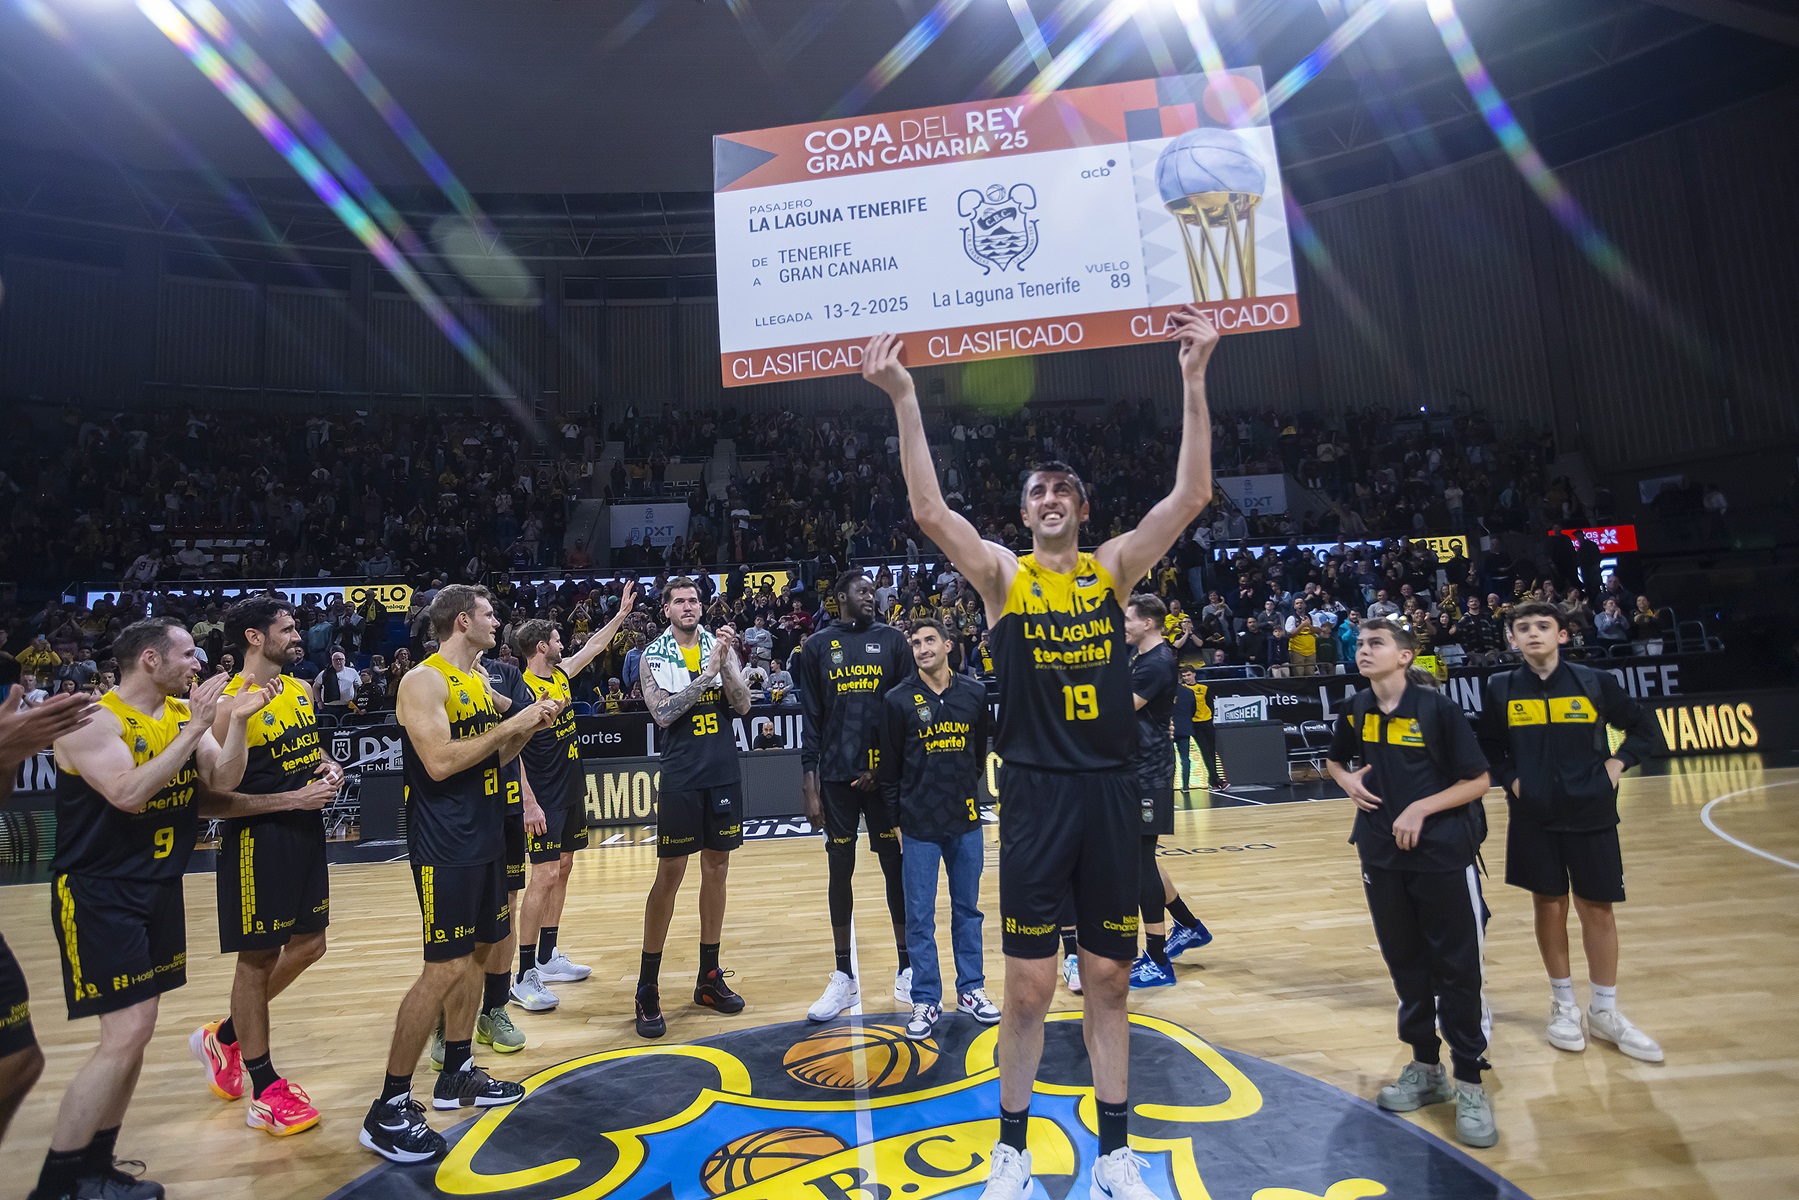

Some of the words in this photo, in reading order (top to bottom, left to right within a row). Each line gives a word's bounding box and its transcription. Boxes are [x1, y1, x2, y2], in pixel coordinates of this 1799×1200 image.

[804, 123, 893, 154] COPA
[900, 116, 958, 142] DEL
[965, 105, 1025, 134] REY
[806, 149, 875, 174] GRAN
[880, 135, 990, 164] CANARIA
[1080, 167, 1110, 179] acb
[749, 198, 813, 214] PASAJERO
[749, 217, 770, 233] LA
[774, 207, 844, 230] LAGUNA
[847, 197, 928, 220] TENERIFE
[752, 257, 768, 267] DE
[778, 242, 852, 264] TENERIFE
[779, 265, 823, 283] GRAN
[828, 256, 898, 277] CANARIA
[1085, 260, 1130, 273] VUELO
[753, 277, 761, 286] A
[932, 292, 950, 307] La
[956, 284, 1014, 307] Laguna
[1017, 276, 1080, 298] Tenerife
[1110, 273, 1131, 289] 89
[755, 312, 813, 327] LLEGADA
[824, 296, 908, 319] 13-2-2025
[1130, 302, 1288, 338] CLAFICADO
[928, 321, 1083, 358] CLASIFICADO
[732, 345, 865, 380] CLASIFICAD
[645, 526, 674, 537] DXT
[351, 586, 406, 603] CLO
[1024, 622, 1046, 640] LA
[1050, 616, 1114, 642] LAGUNA
[829, 670, 843, 680] LA
[845, 665, 883, 676] LAGUNA
[1062, 683, 1099, 721] 19
[460, 725, 476, 739] LA
[691, 713, 718, 736] 35
[919, 726, 933, 739] LA
[935, 721, 969, 735] LAGUNA
[1656, 703, 1758, 751] VAMOS
[271, 743, 291, 759] LA
[484, 768, 498, 795] 21
[506, 781, 520, 804] 2
[966, 798, 978, 821] 3
[153, 826, 174, 859] 9
[670, 836, 694, 844] Hospiten
[1018, 924, 1056, 937] Hospiten
